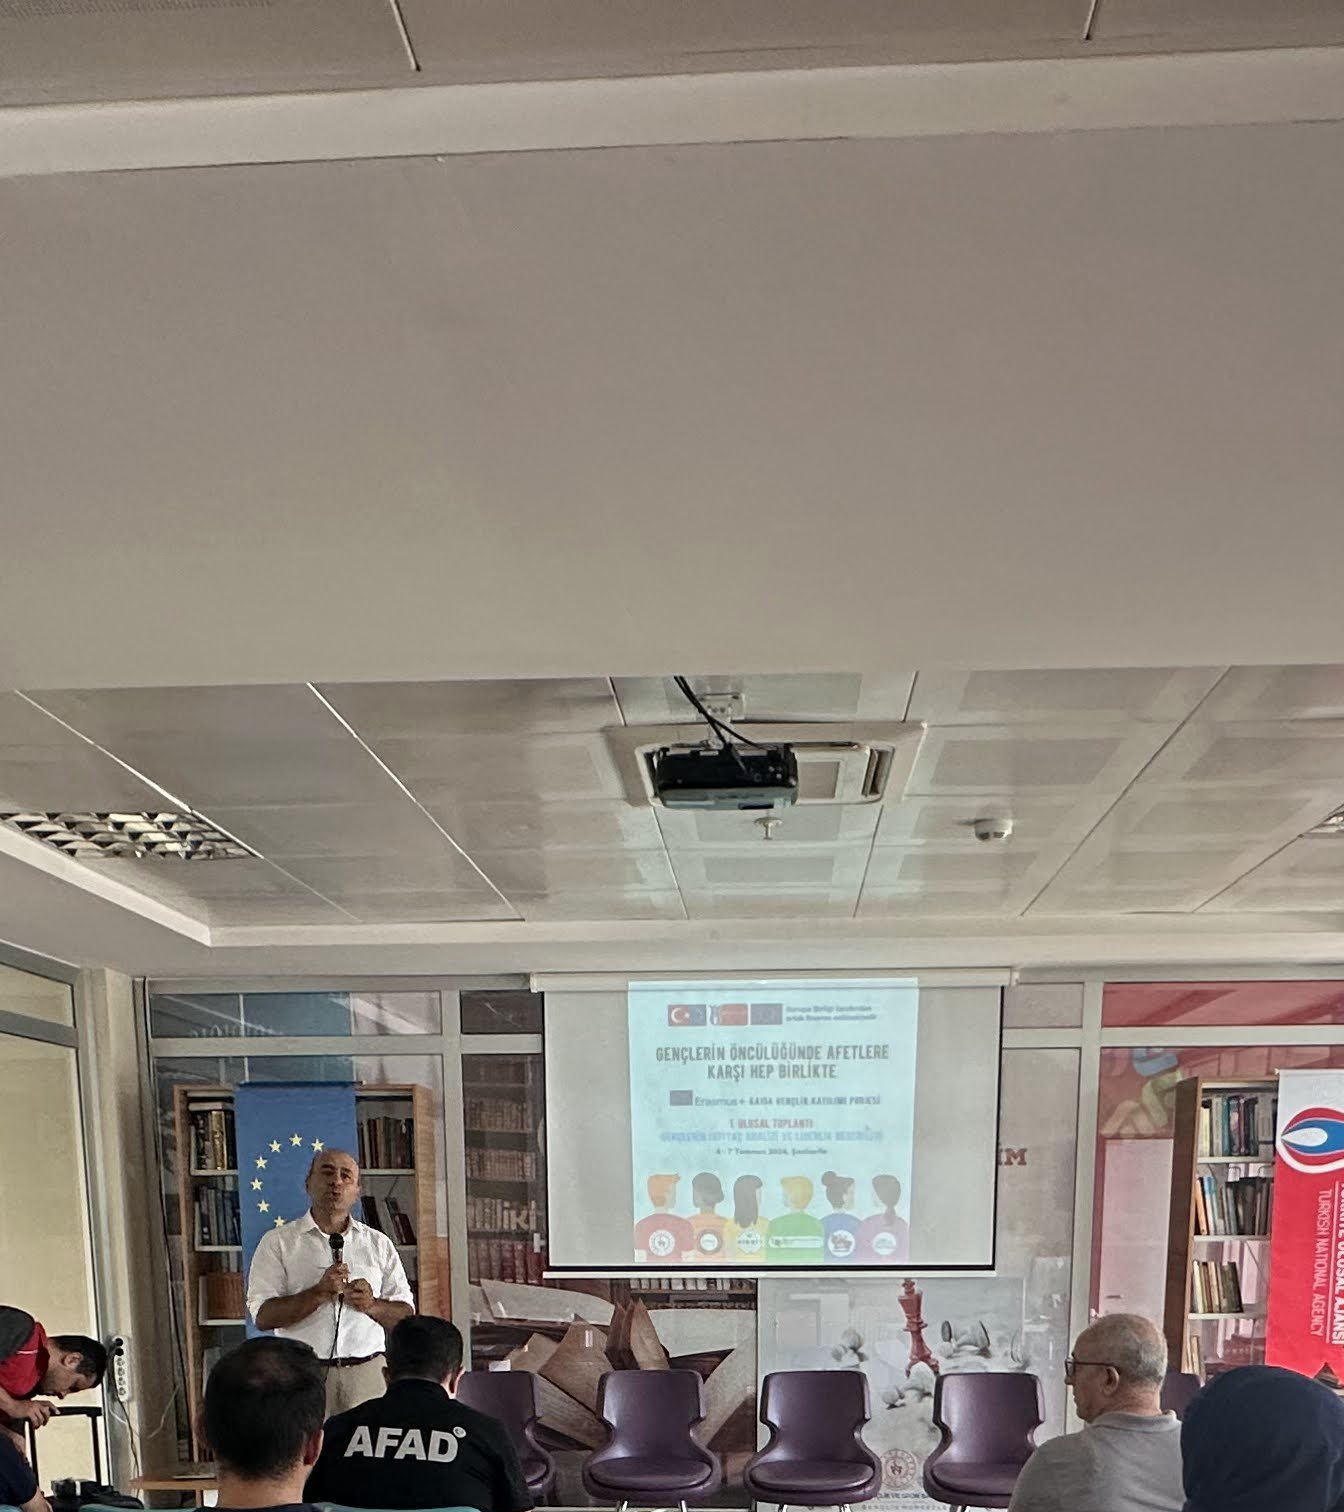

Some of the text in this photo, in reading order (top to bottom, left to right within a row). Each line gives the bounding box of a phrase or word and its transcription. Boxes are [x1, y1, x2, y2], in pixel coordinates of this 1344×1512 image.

[656, 1042, 889, 1065] GENÇLERİN ÖNCÜLÜĞÜNDE AFETLERE
[707, 1061, 836, 1082] KARŞI HEP BİRLİKTE
[1310, 1189, 1332, 1337] TURKISH NATIONAL AGENCY
[344, 1426, 459, 1463] AFAD
